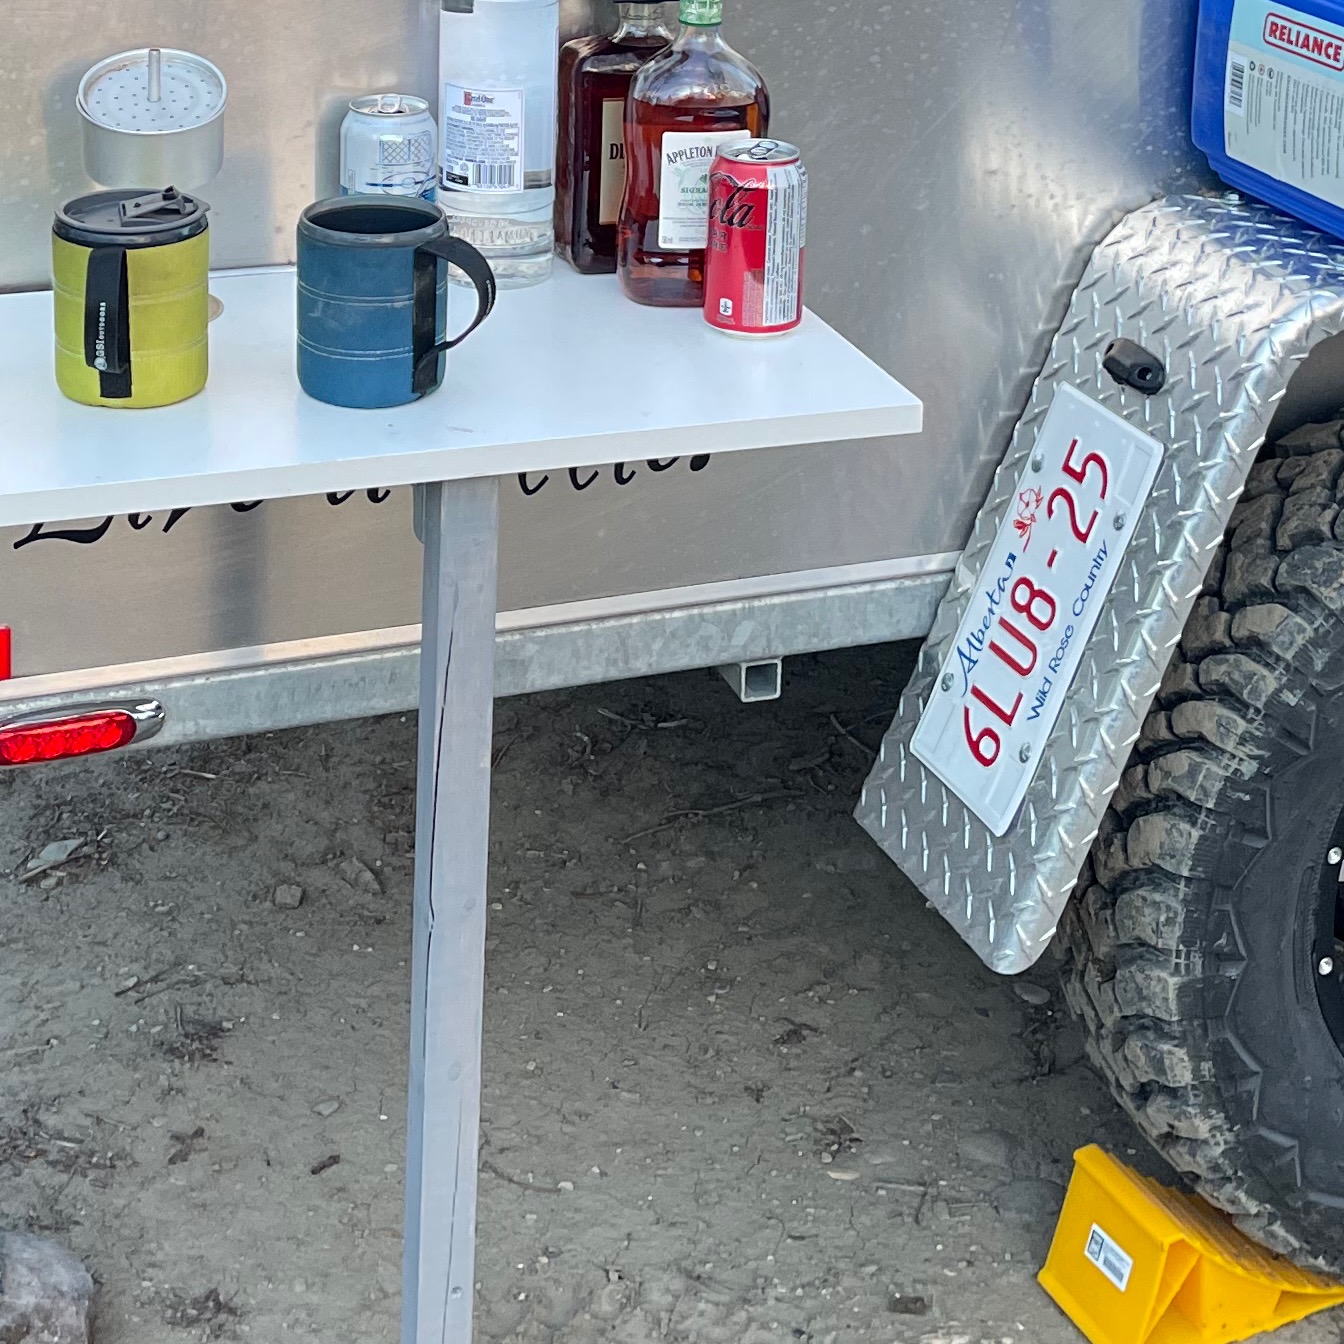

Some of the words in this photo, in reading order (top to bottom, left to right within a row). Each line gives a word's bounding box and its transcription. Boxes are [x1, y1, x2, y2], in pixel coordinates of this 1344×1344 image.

[1268, 21, 1342, 64] RELIANCE
[666, 146, 713, 166] APPLETON
[957, 564, 1014, 698] Alberta
[1026, 677, 1053, 722] Wild
[1048, 623, 1074, 675] Rose
[1071, 539, 1108, 618] Country
